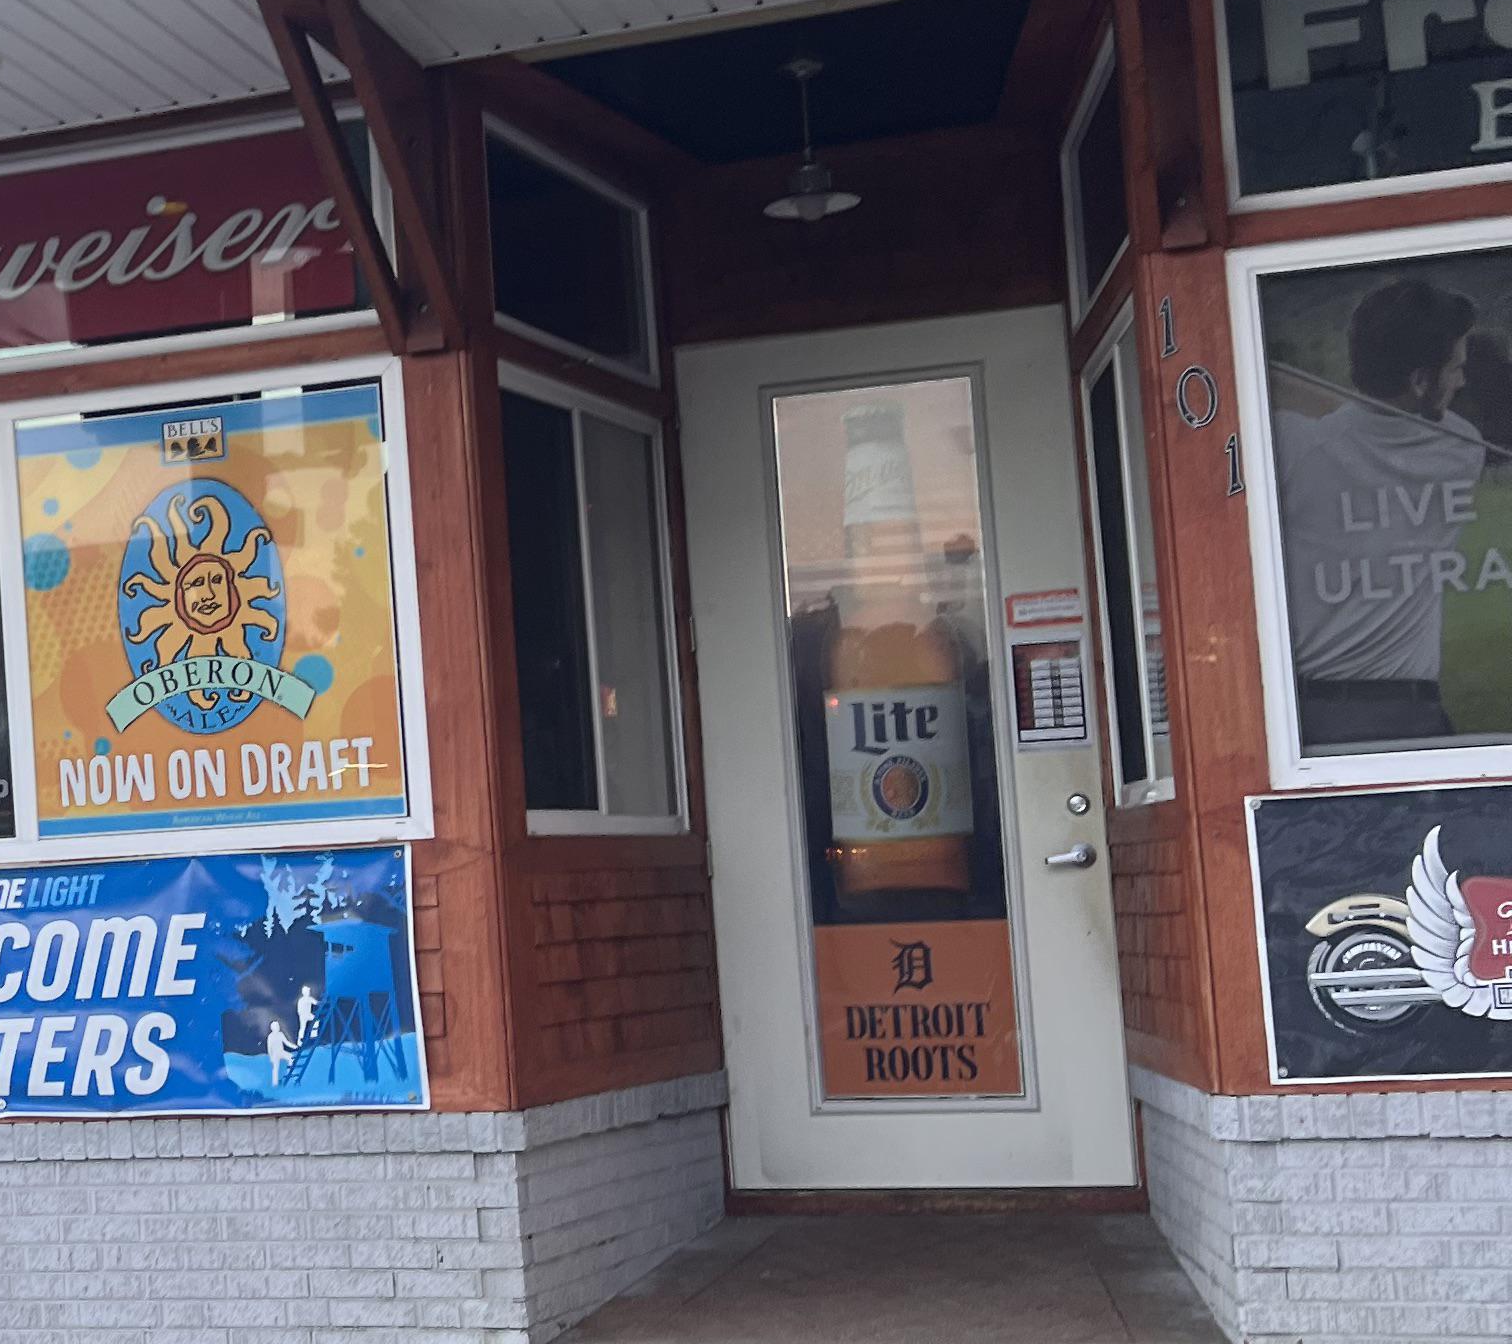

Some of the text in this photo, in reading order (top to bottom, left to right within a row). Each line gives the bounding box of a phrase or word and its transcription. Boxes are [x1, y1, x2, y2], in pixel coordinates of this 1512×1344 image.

[1341, 479, 1477, 532] LIVE
[1315, 547, 1512, 603] ULTRA
[132, 658, 286, 706] OBERON
[176, 705, 236, 730] ALE
[849, 702, 939, 755] Lite
[59, 736, 374, 807] NOW ON DRAFT
[24, 873, 106, 908] LIGHT
[845, 1001, 991, 1040] DETROIT
[865, 1044, 978, 1082] ROOTS
